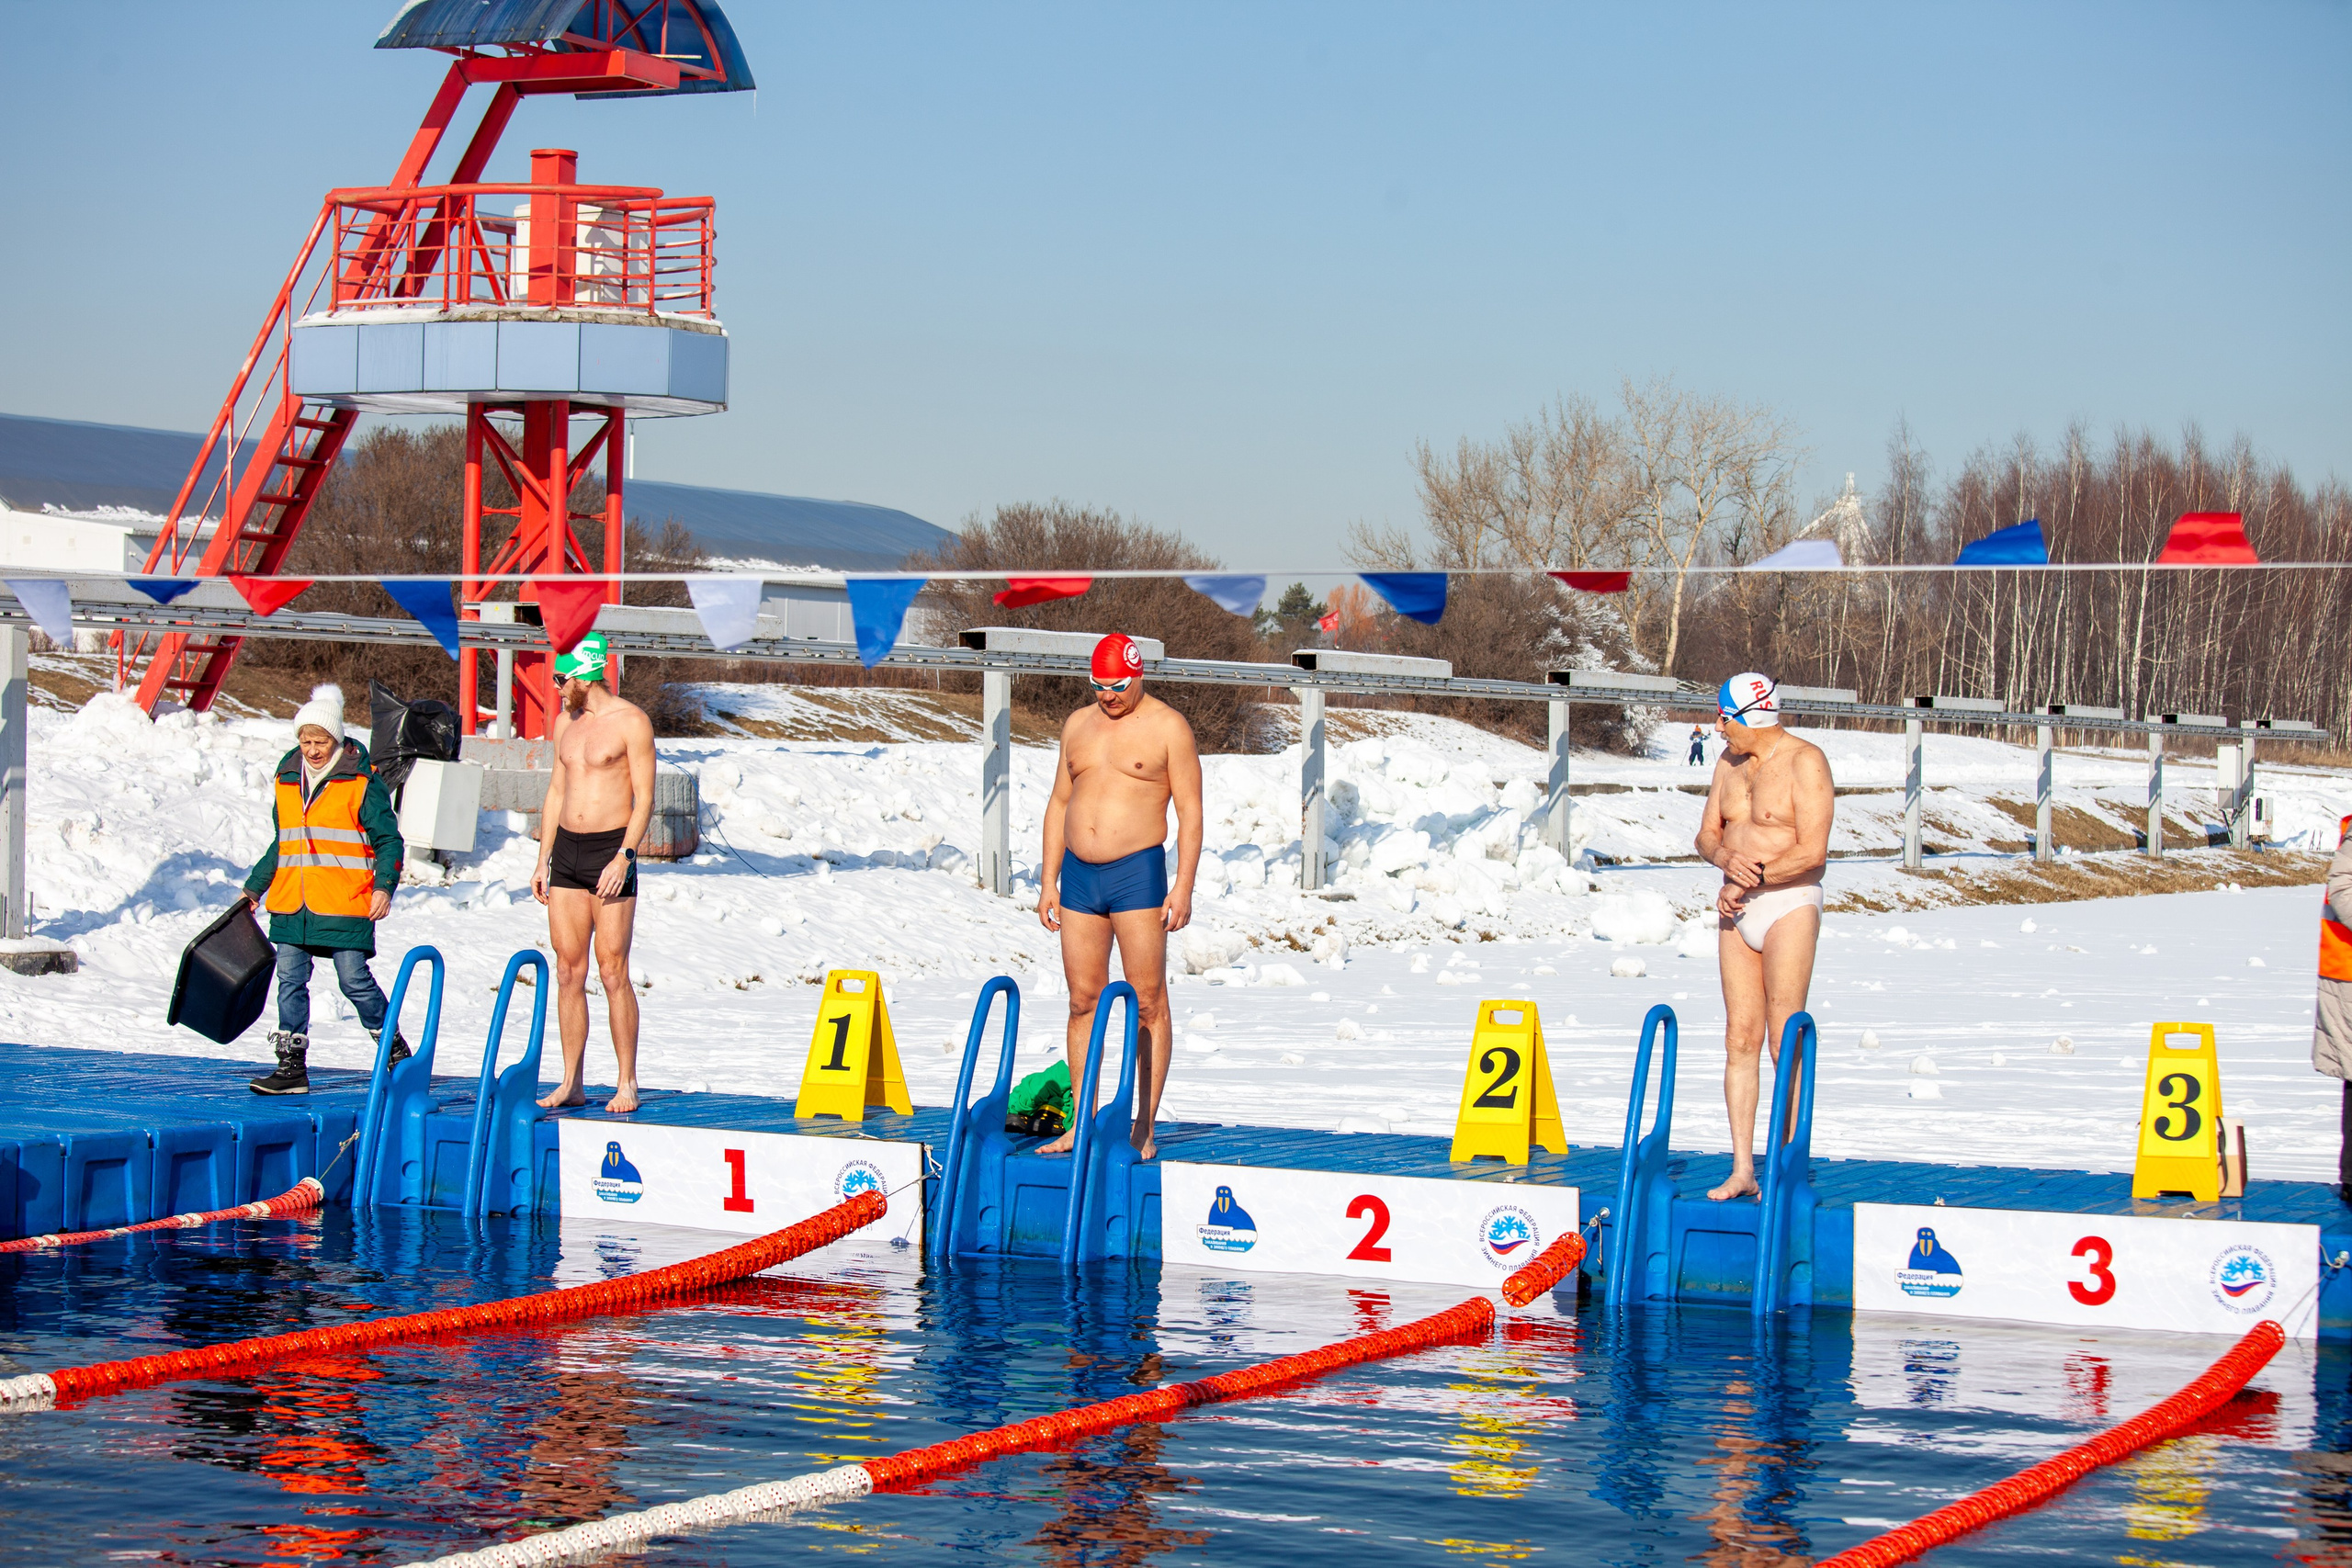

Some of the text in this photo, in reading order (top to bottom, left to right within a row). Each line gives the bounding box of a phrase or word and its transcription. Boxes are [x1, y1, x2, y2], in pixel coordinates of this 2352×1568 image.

[820, 1013, 851, 1071] 1
[1473, 1047, 1521, 1109] 2
[2154, 1073, 2201, 1141] 3
[723, 1148, 754, 1213] 1
[834, 1159, 868, 1194] ВСЕРОССИЙСКАЯ
[1198, 1227, 1231, 1235] Федерация
[1346, 1194, 1392, 1262] 2
[1479, 1204, 1540, 1247] ВСЕРОССИЙСКАЯ ФЕДЕРАЦИЯ
[1481, 1247, 1508, 1271] ЗИМНЕГО
[1896, 1271, 1934, 1280] Федерация
[2067, 1235, 2116, 1305] 3
